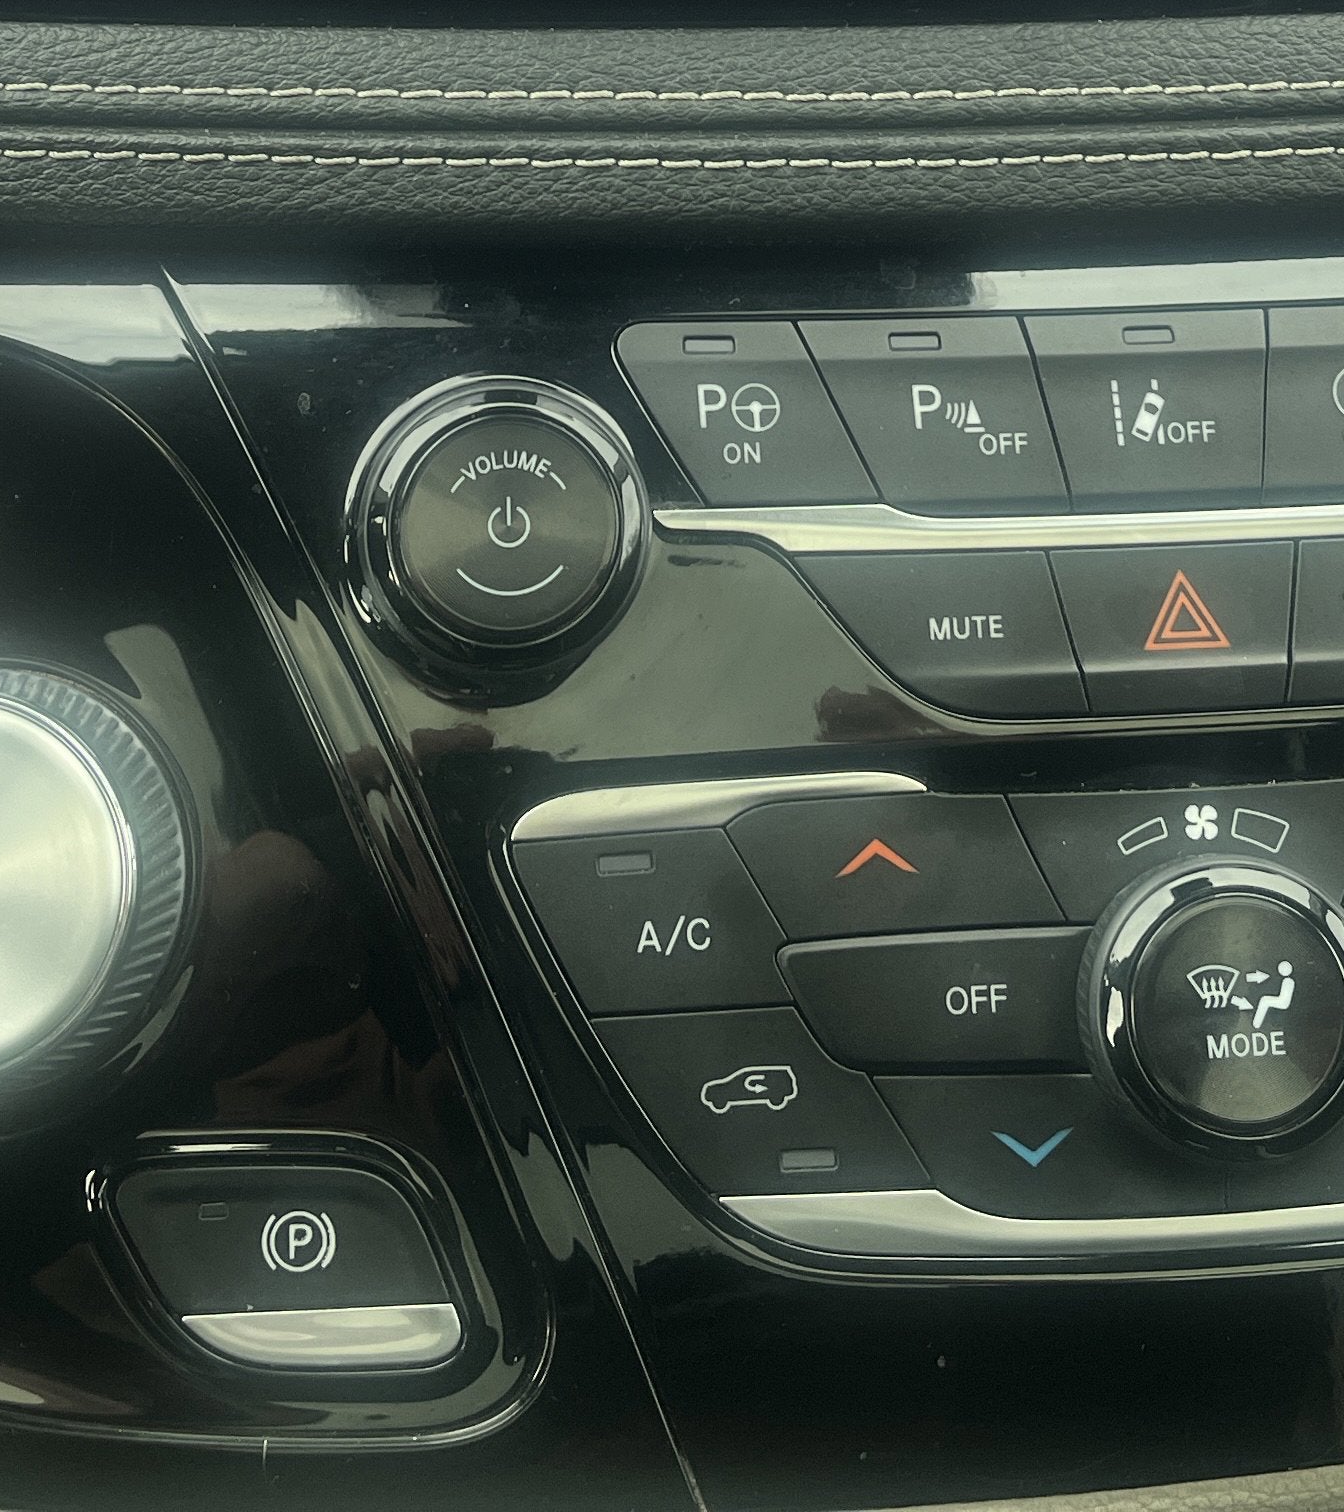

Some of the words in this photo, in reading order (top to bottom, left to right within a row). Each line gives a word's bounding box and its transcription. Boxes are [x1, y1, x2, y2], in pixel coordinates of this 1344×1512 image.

[978, 431, 1029, 456] OFF
[1166, 420, 1216, 445] OFF
[460, 448, 552, 482] VOLUME
[722, 441, 762, 465] ON
[928, 614, 1005, 641] MUTE
[636, 914, 712, 957] A/C
[944, 983, 1009, 1016] OFF
[1206, 1032, 1287, 1061] MODE
